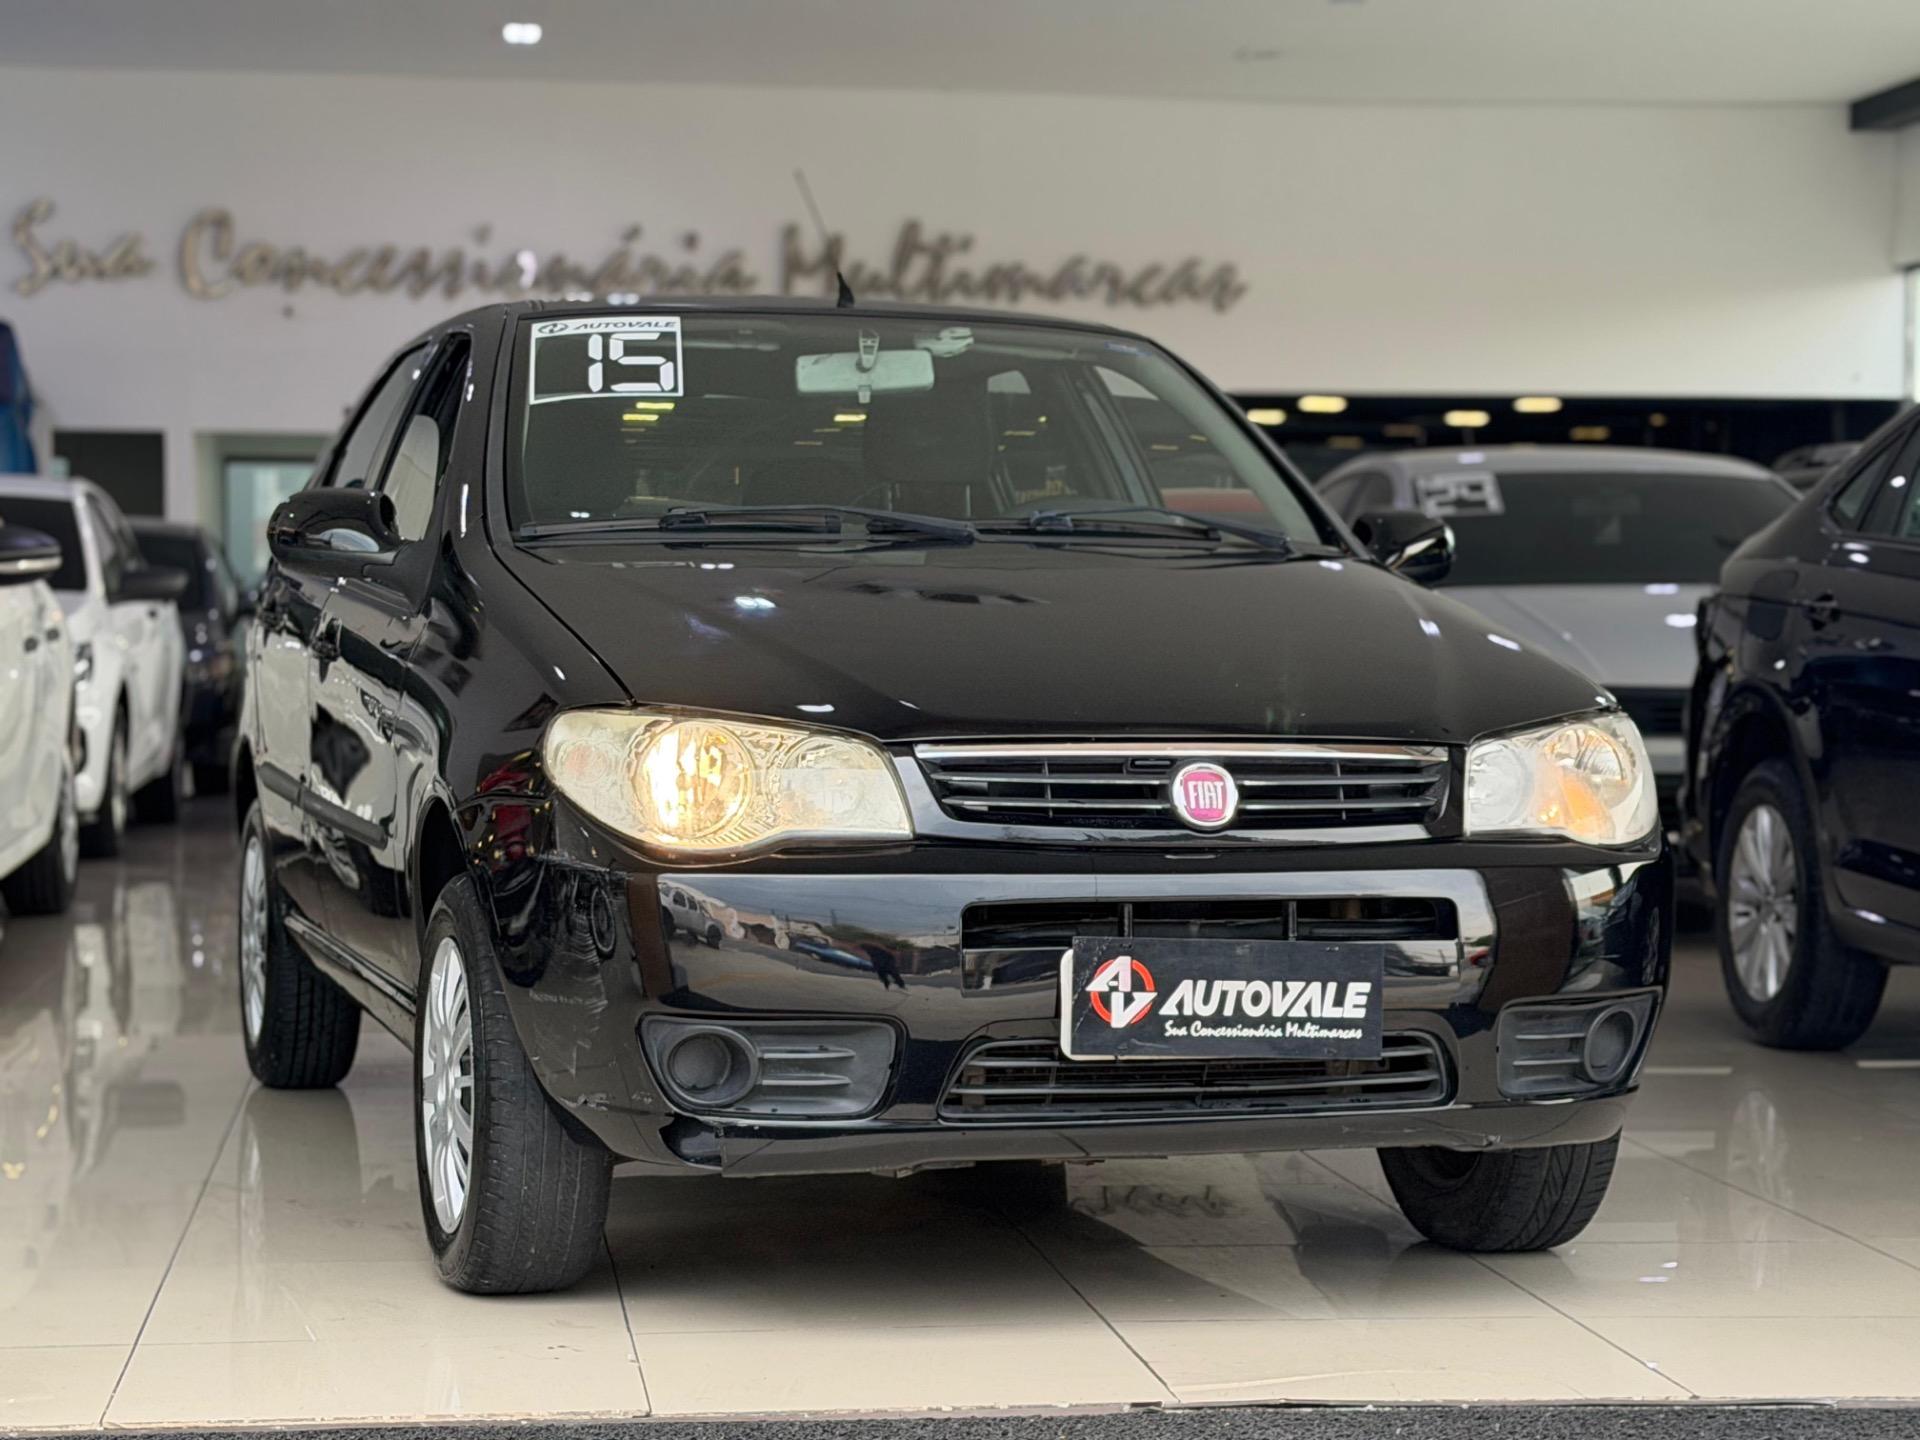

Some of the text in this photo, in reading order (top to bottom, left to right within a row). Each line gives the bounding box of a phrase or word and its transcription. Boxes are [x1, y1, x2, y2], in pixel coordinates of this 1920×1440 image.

[575, 321, 676, 330] AUTOVALE
[588, 332, 674, 392] 15
[1187, 781, 1224, 809] FIAT
[1158, 979, 1372, 1018] AUTOVALE
[1164, 1020, 1188, 1037] Sua
